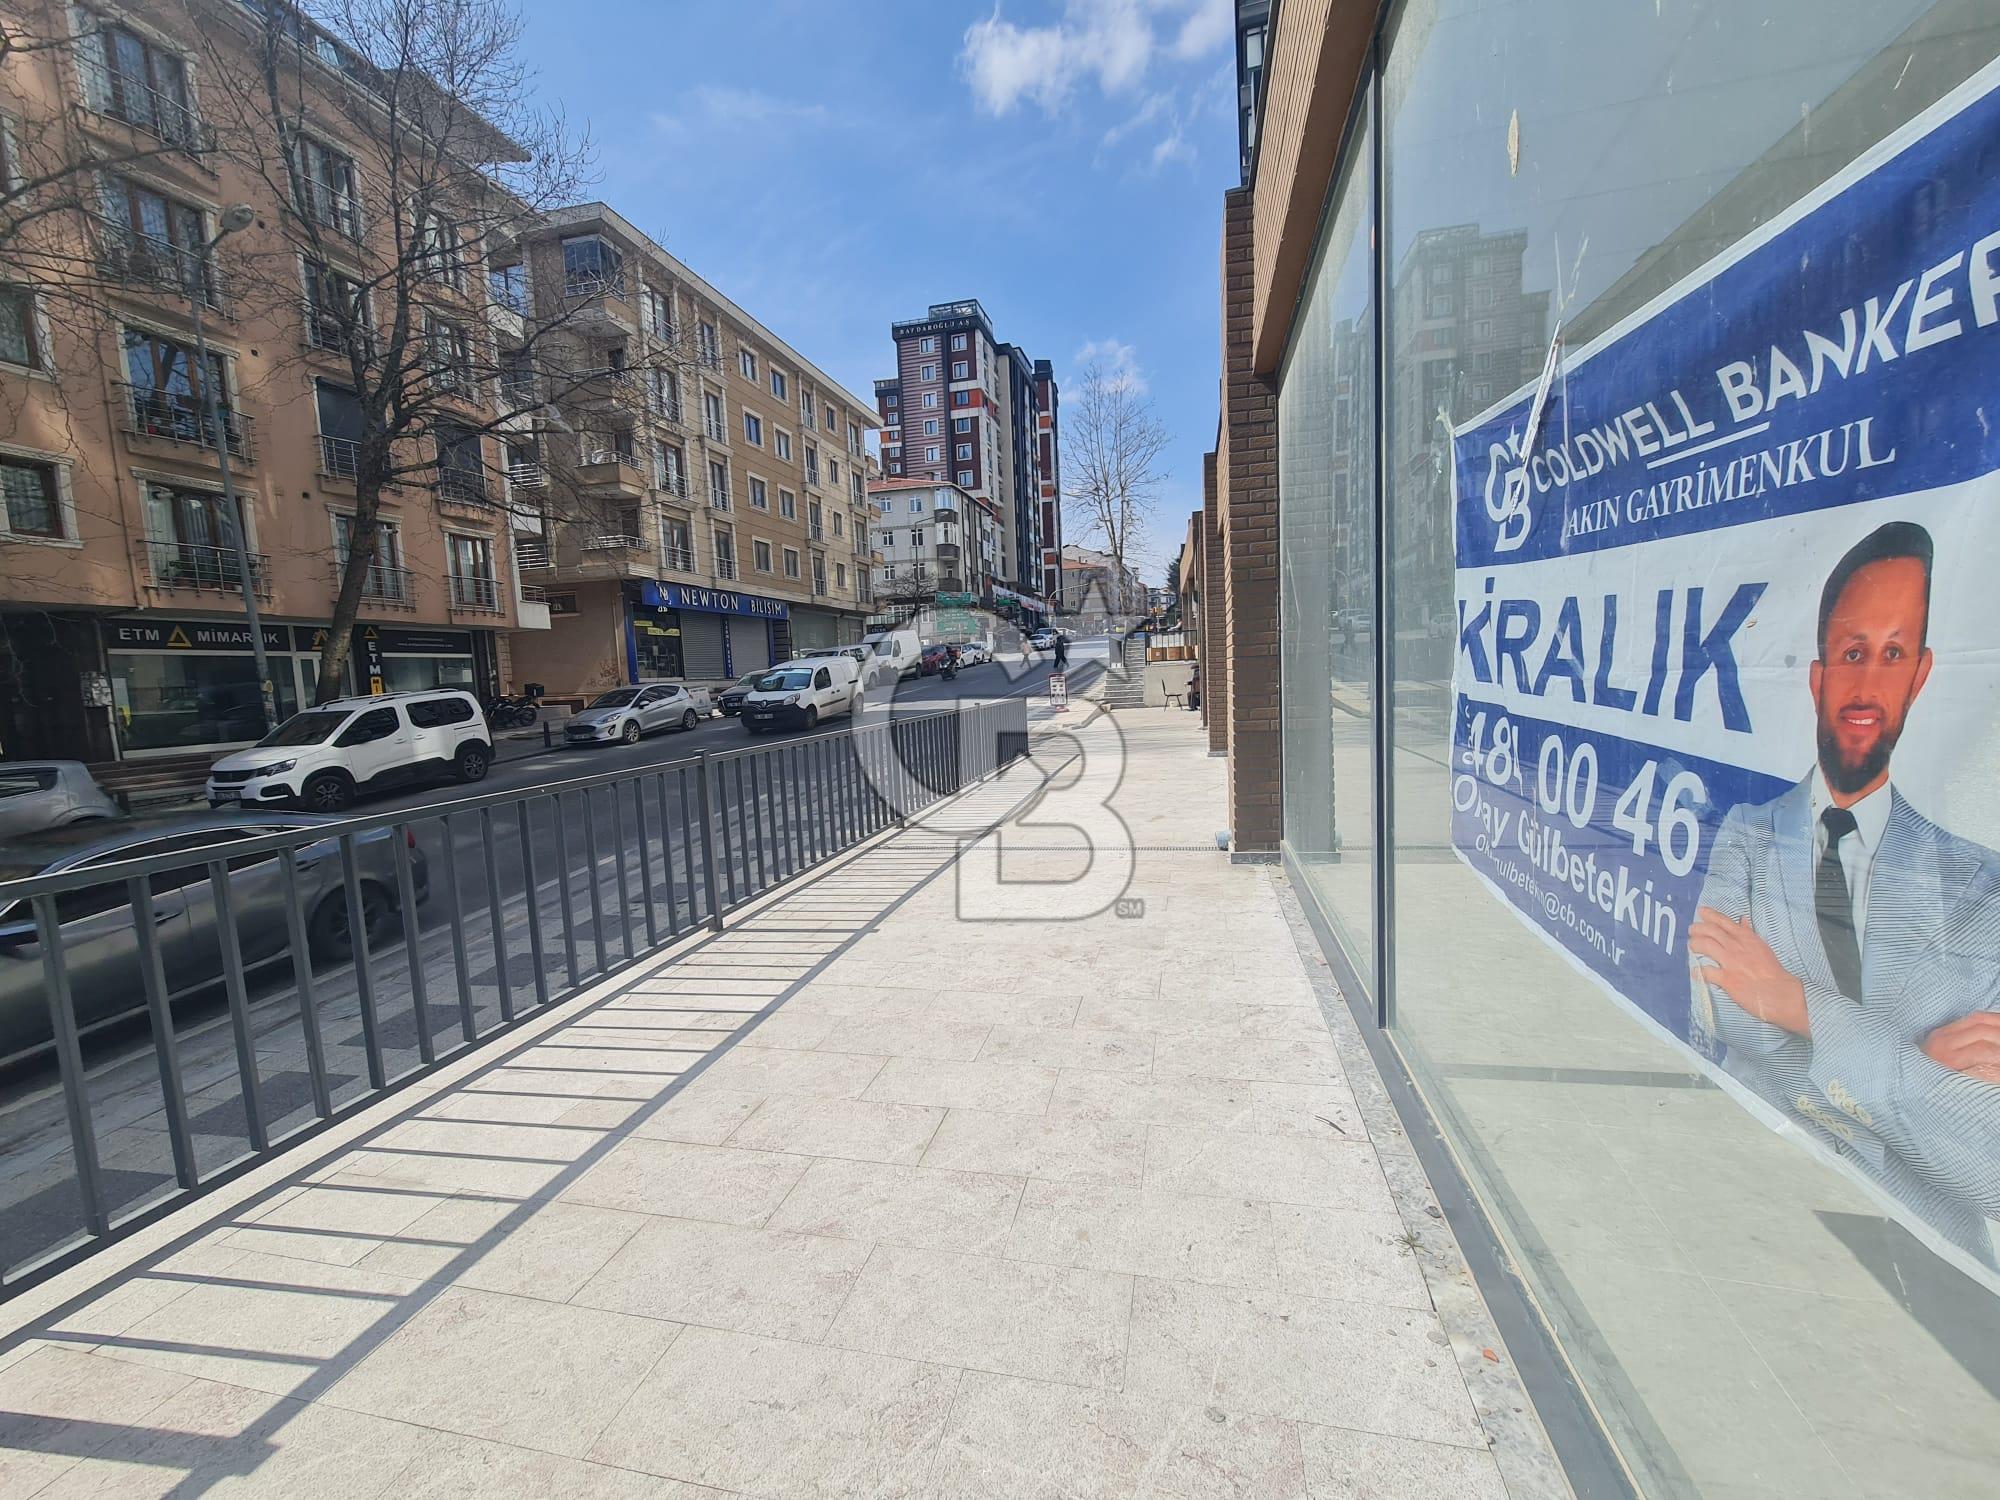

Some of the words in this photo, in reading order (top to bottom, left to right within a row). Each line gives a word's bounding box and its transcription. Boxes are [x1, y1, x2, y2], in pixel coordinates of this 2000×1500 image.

[1531, 390, 1716, 494] COLDWELL
[1566, 497, 1621, 538] AKIN
[1626, 416, 1896, 525] GAYRİMENKUL
[118, 627, 160, 641] ETM
[197, 628, 280, 644] MİMARIK
[680, 588, 739, 611] NEWTON
[1458, 577, 1769, 734] KİRALIK
[367, 641, 381, 675] ETM
[1538, 734, 1599, 830] 00
[1612, 759, 1706, 878] 46
[1517, 809, 1677, 956] Gülbetekin
